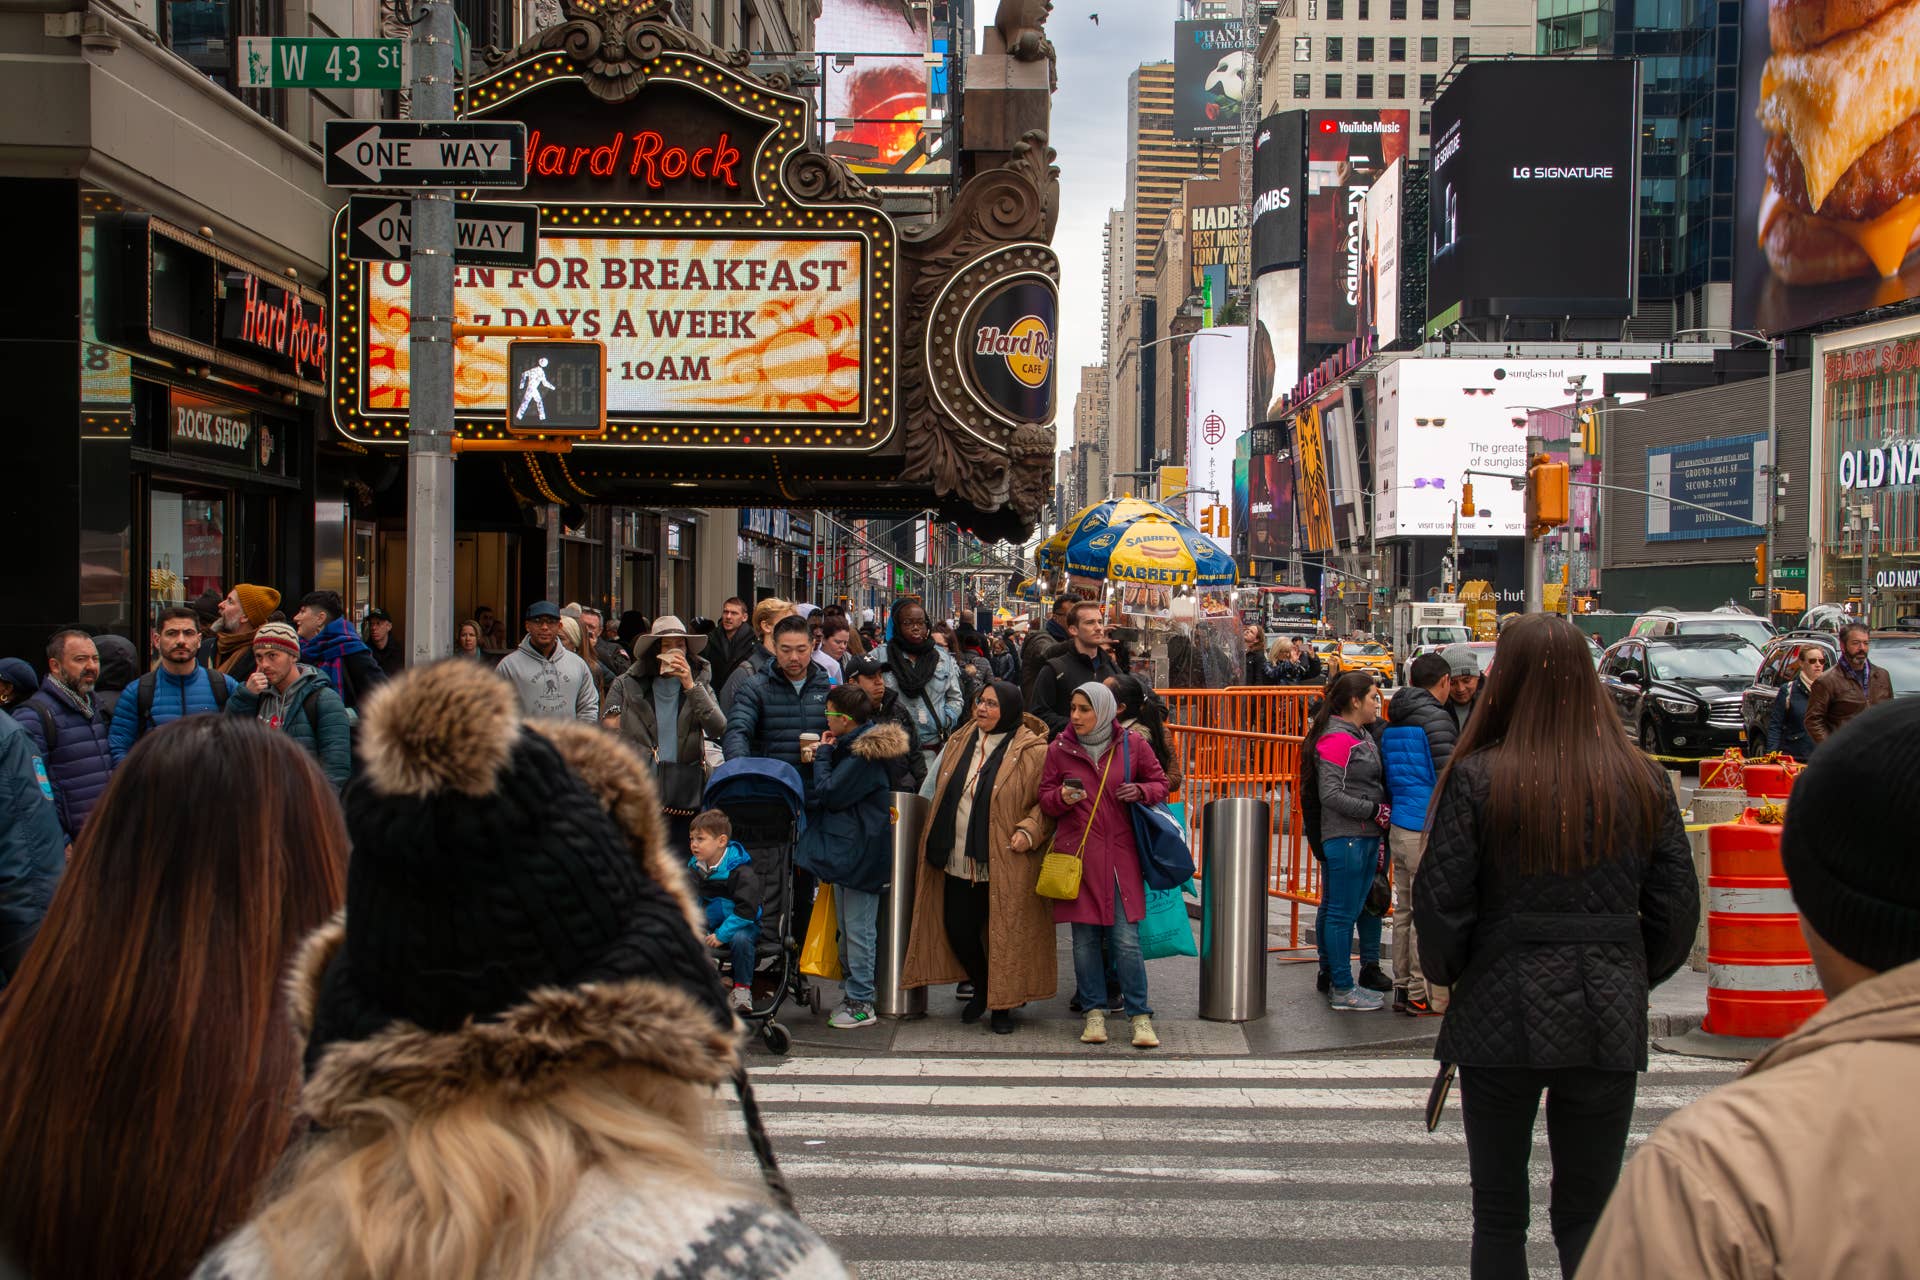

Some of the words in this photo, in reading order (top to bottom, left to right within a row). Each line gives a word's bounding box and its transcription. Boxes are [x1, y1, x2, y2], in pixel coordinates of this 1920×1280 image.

[1194, 29, 1256, 43] PHANTO
[280, 45, 308, 81] W
[325, 46, 361, 82] 43
[377, 46, 400, 68] St
[1338, 121, 1372, 133] YouTube
[1373, 121, 1400, 133] Music
[356, 142, 412, 167] ONE
[439, 143, 499, 168] WAY
[630, 130, 740, 187] Rock
[1513, 167, 1530, 179] LG
[1534, 167, 1613, 179] SIGNATURE
[378, 217, 412, 242] ON
[457, 222, 513, 249] WAY
[1192, 230, 1216, 248] BEST
[1193, 248, 1220, 265] TONY
[382, 261, 495, 288] ON
[508, 257, 591, 289] FOR
[601, 258, 848, 291] BREAKFAST
[242, 273, 289, 354] Hard
[288, 292, 328, 382] Rock
[473, 315, 492, 342] 7
[502, 308, 601, 338] DAYS
[611, 309, 638, 338] A
[647, 310, 757, 339] WEEK
[976, 326, 1034, 357] Hard
[621, 356, 712, 381] 10AM
[1022, 363, 1043, 375] CAFE
[1508, 369, 1548, 380] sunglass
[1548, 368, 1565, 379] hut
[1825, 349, 1877, 384] SPARK
[176, 406, 213, 442] ROCK
[215, 416, 249, 450] SHOP
[1469, 442, 1489, 453] The
[1470, 456, 1481, 466] of
[1839, 448, 1886, 490] OLD
[1125, 535, 1177, 547] SABRETT
[1112, 563, 1191, 582] SABRETT
[1781, 569, 1788, 577] W
[1790, 568, 1799, 577] 44
[1876, 571, 1896, 587] OLD
[1459, 591, 1502, 604] nglass
[1503, 588, 1526, 602] hut
